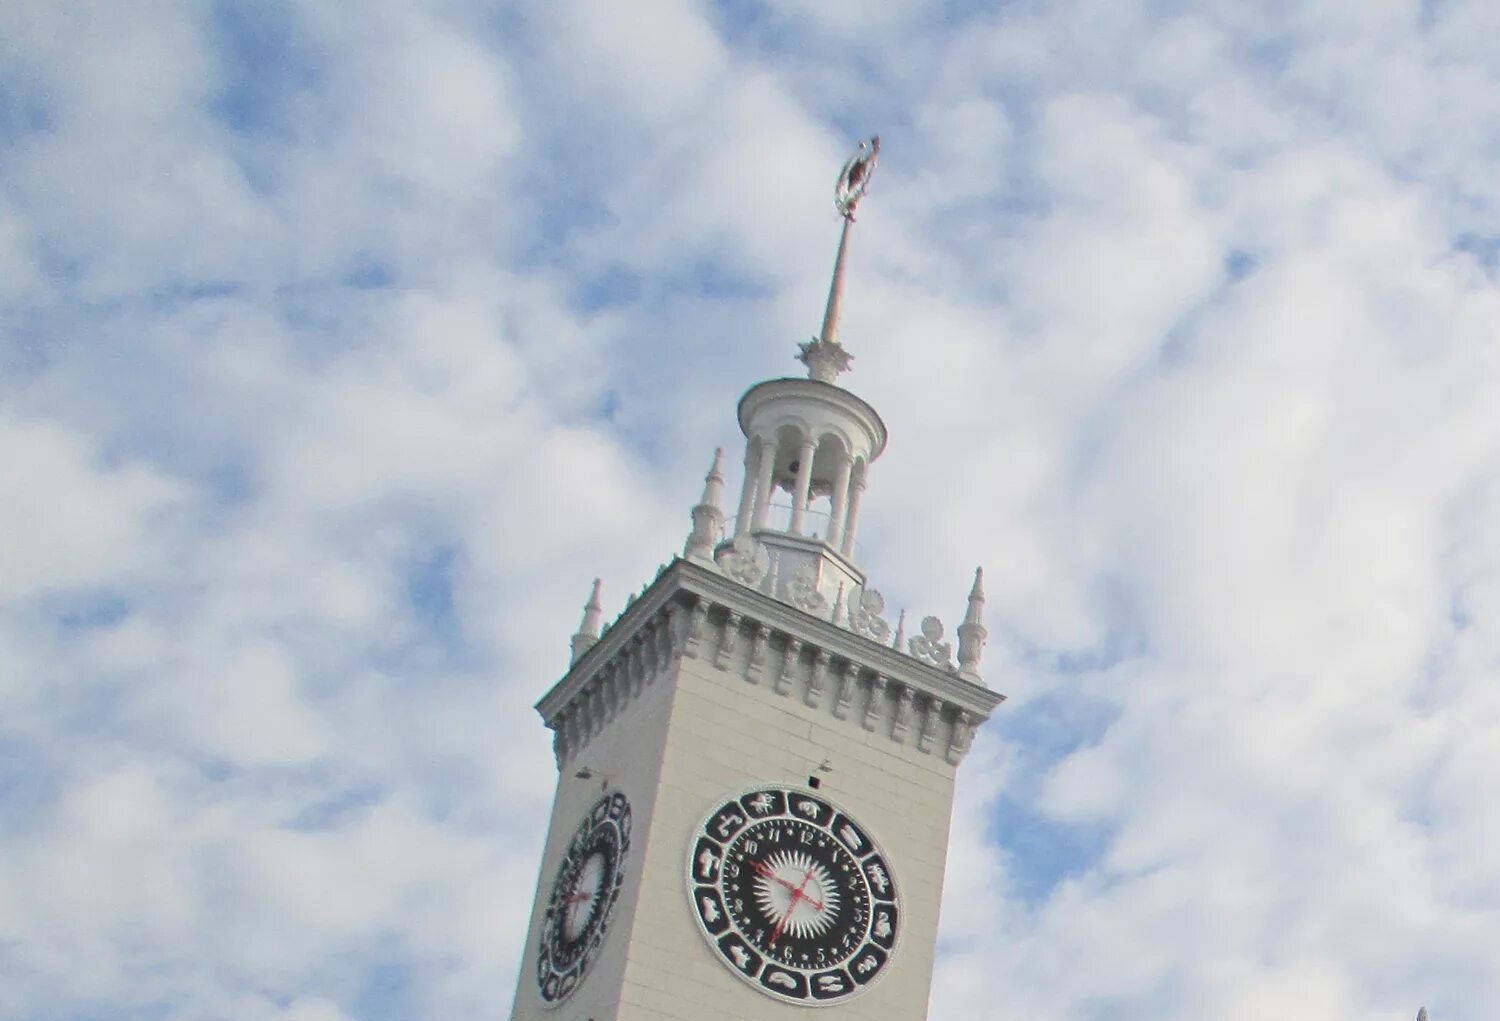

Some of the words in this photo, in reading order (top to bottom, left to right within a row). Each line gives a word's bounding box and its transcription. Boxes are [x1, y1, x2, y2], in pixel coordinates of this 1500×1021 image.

[769, 828, 780, 843] 11
[801, 830, 814, 846] 12
[745, 839, 758, 855] 10
[731, 863, 739, 878] 9
[848, 877, 857, 890] 2
[734, 898, 743, 913] 8
[854, 908, 863, 922] 3
[756, 929, 764, 942] 7
[843, 933, 850, 948] 4
[784, 945, 793, 960] 6
[818, 947, 825, 962] 5
